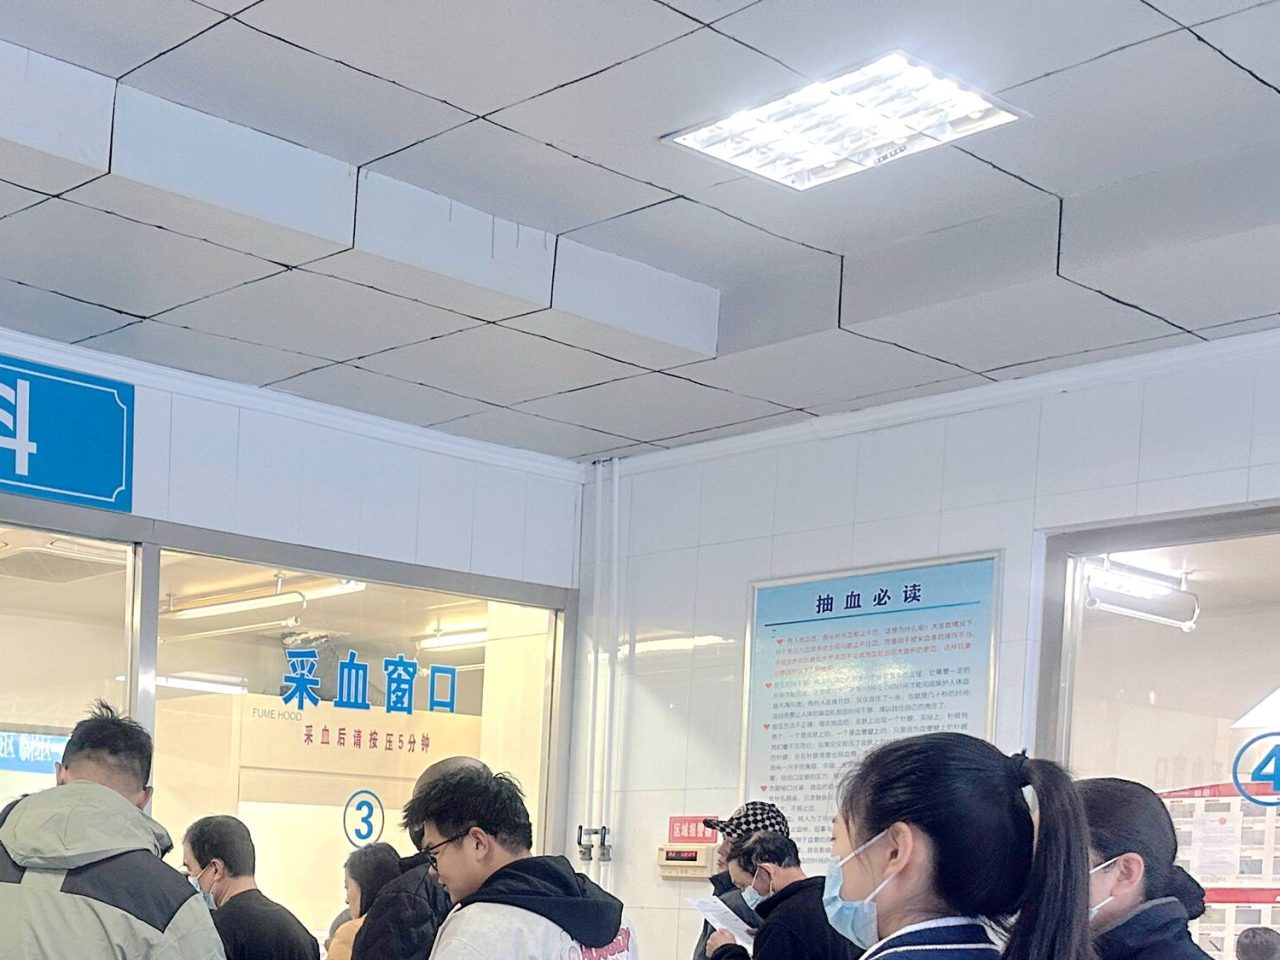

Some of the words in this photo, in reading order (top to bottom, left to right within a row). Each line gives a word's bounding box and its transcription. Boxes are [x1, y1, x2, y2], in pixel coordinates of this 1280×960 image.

[816, 583, 922, 615] 抽血必读
[281, 648, 458, 715] 采血窗口
[252, 706, 276, 719] FUME
[278, 709, 302, 722] HOOD
[303, 723, 431, 754] 采血后请按压5分钟
